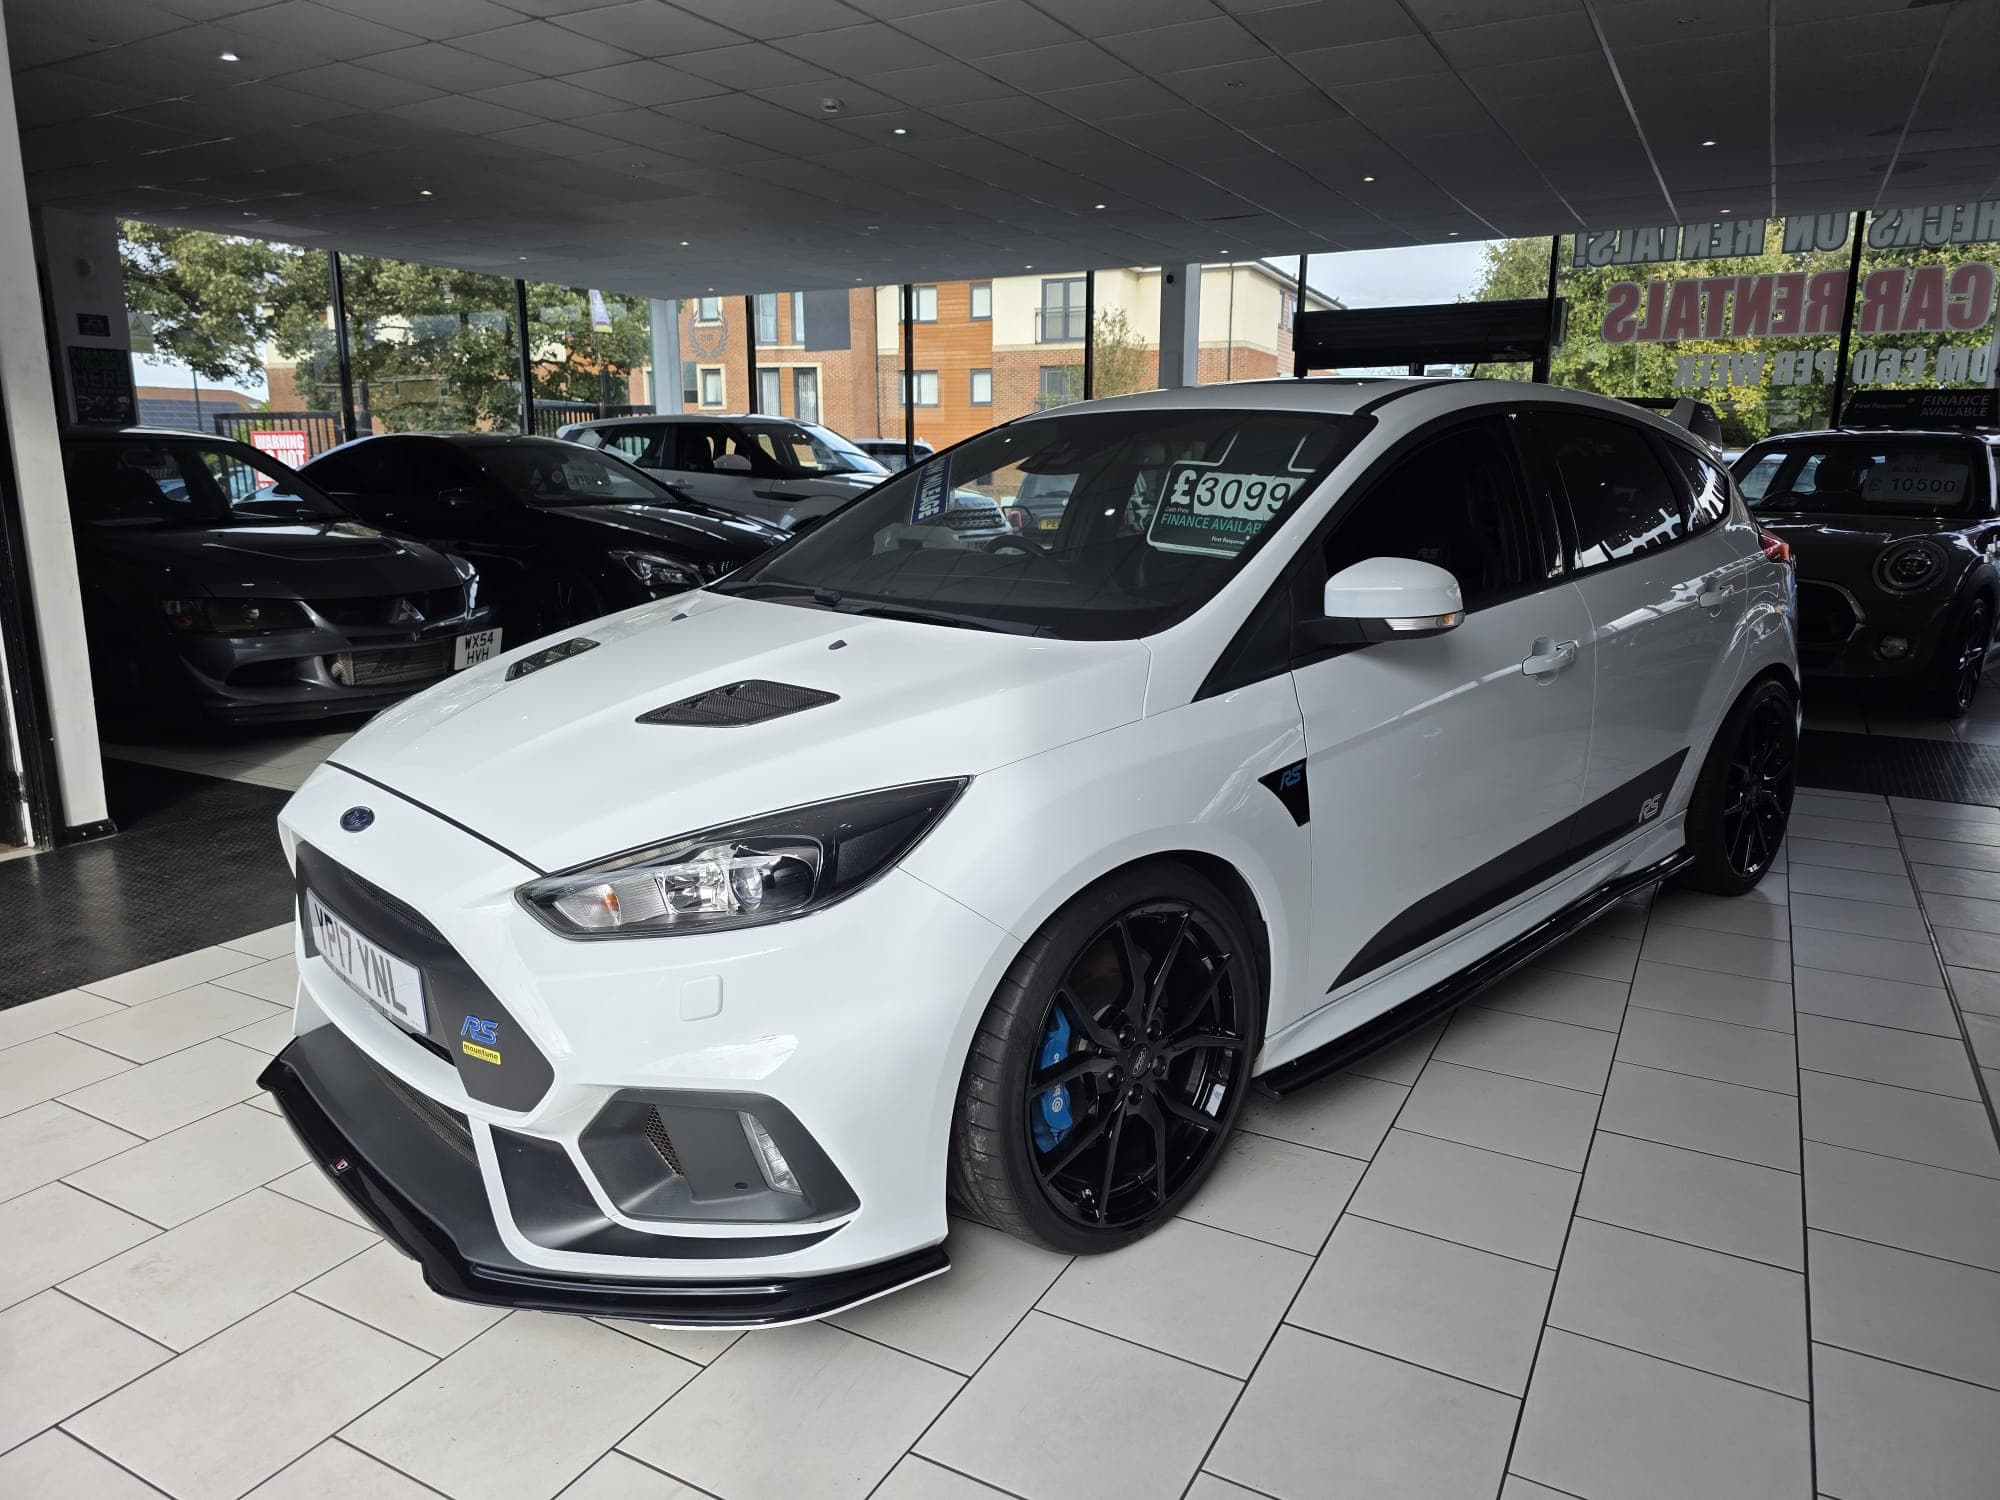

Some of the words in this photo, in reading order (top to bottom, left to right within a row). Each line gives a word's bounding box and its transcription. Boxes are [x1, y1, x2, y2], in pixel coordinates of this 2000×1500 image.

[1922, 394, 1991, 406] FINANCE
[1920, 407, 1988, 417] AVAILABLE
[254, 434, 304, 449] WARNING
[1161, 513, 1210, 529] FINANCE
[1211, 518, 1265, 534] AVAILAB
[465, 631, 493, 650] WX54
[467, 647, 490, 665] HVH
[1280, 763, 1304, 791] RS
[1638, 792, 1663, 823] RS
[314, 902, 352, 976] YP17
[356, 938, 408, 1016] YNL
[460, 1015, 500, 1045] RS
[463, 1043, 499, 1060] mountune
